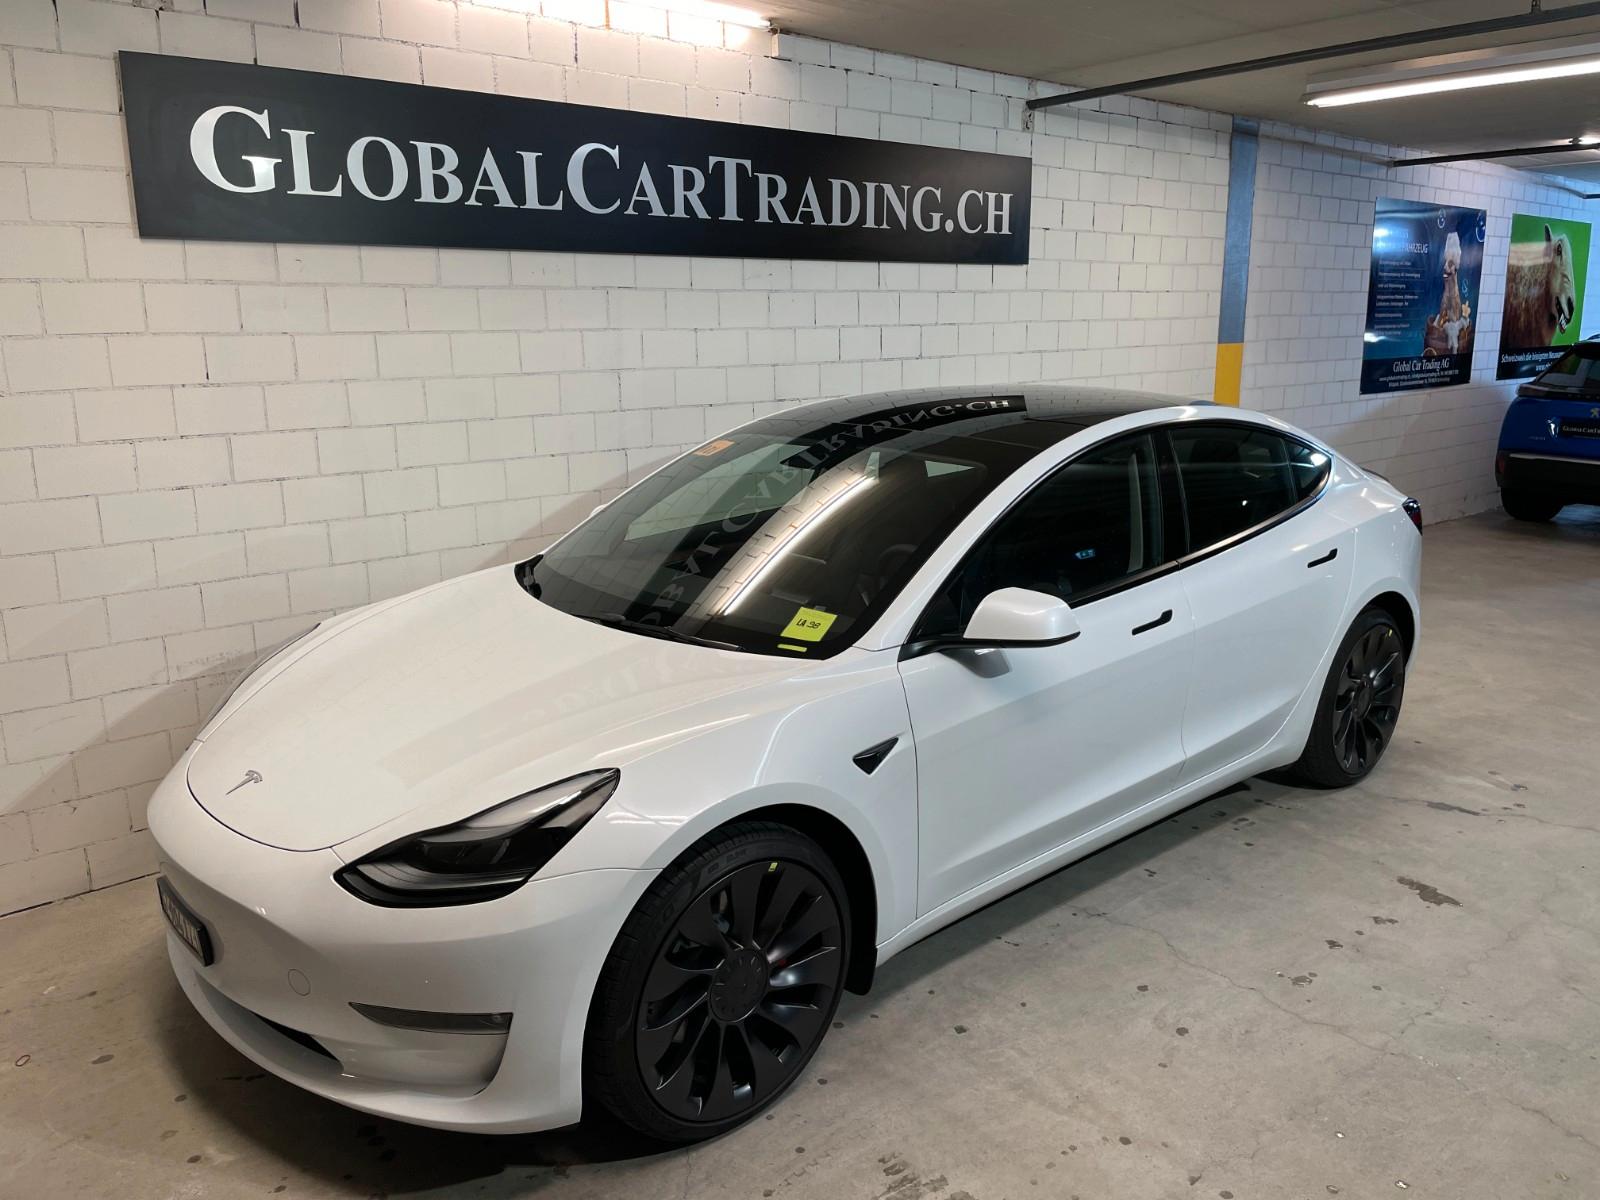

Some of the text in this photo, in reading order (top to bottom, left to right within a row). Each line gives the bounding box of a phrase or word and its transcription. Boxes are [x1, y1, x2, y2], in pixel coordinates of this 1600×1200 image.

[1393, 358, 1450, 372] Global Car Trading AG
